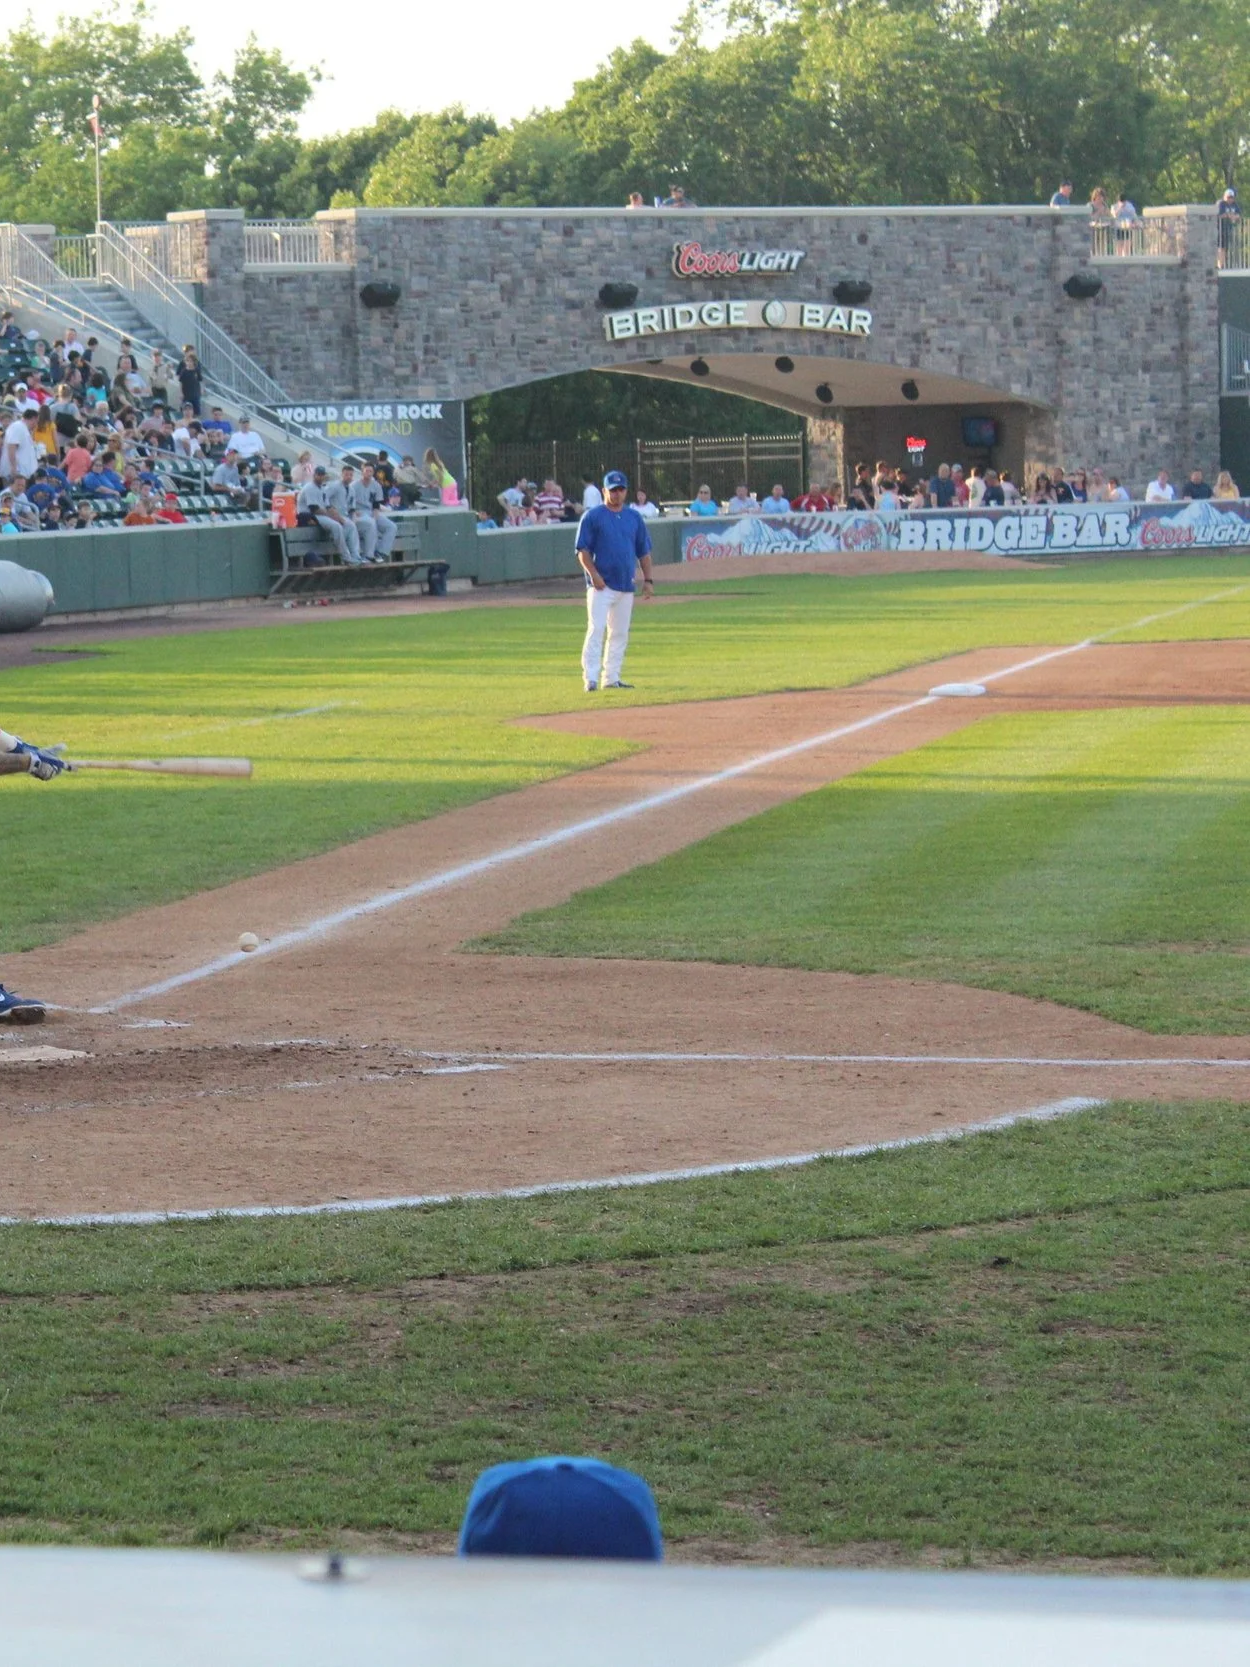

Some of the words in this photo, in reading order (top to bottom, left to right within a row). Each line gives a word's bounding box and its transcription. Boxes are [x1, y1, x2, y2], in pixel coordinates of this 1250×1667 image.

[678, 241, 740, 274] Coors
[740, 251, 804, 271] LIGHT
[610, 302, 750, 338] BRIDGE
[800, 304, 872, 334] BAR
[277, 407, 337, 423] WORLD
[343, 404, 393, 421] CLASS
[398, 404, 443, 419] ROCK
[327, 420, 413, 437] ROCKLAND
[899, 516, 1049, 551] BRIDGE
[1051, 512, 1132, 547] BAR
[1141, 516, 1195, 545] Coors
